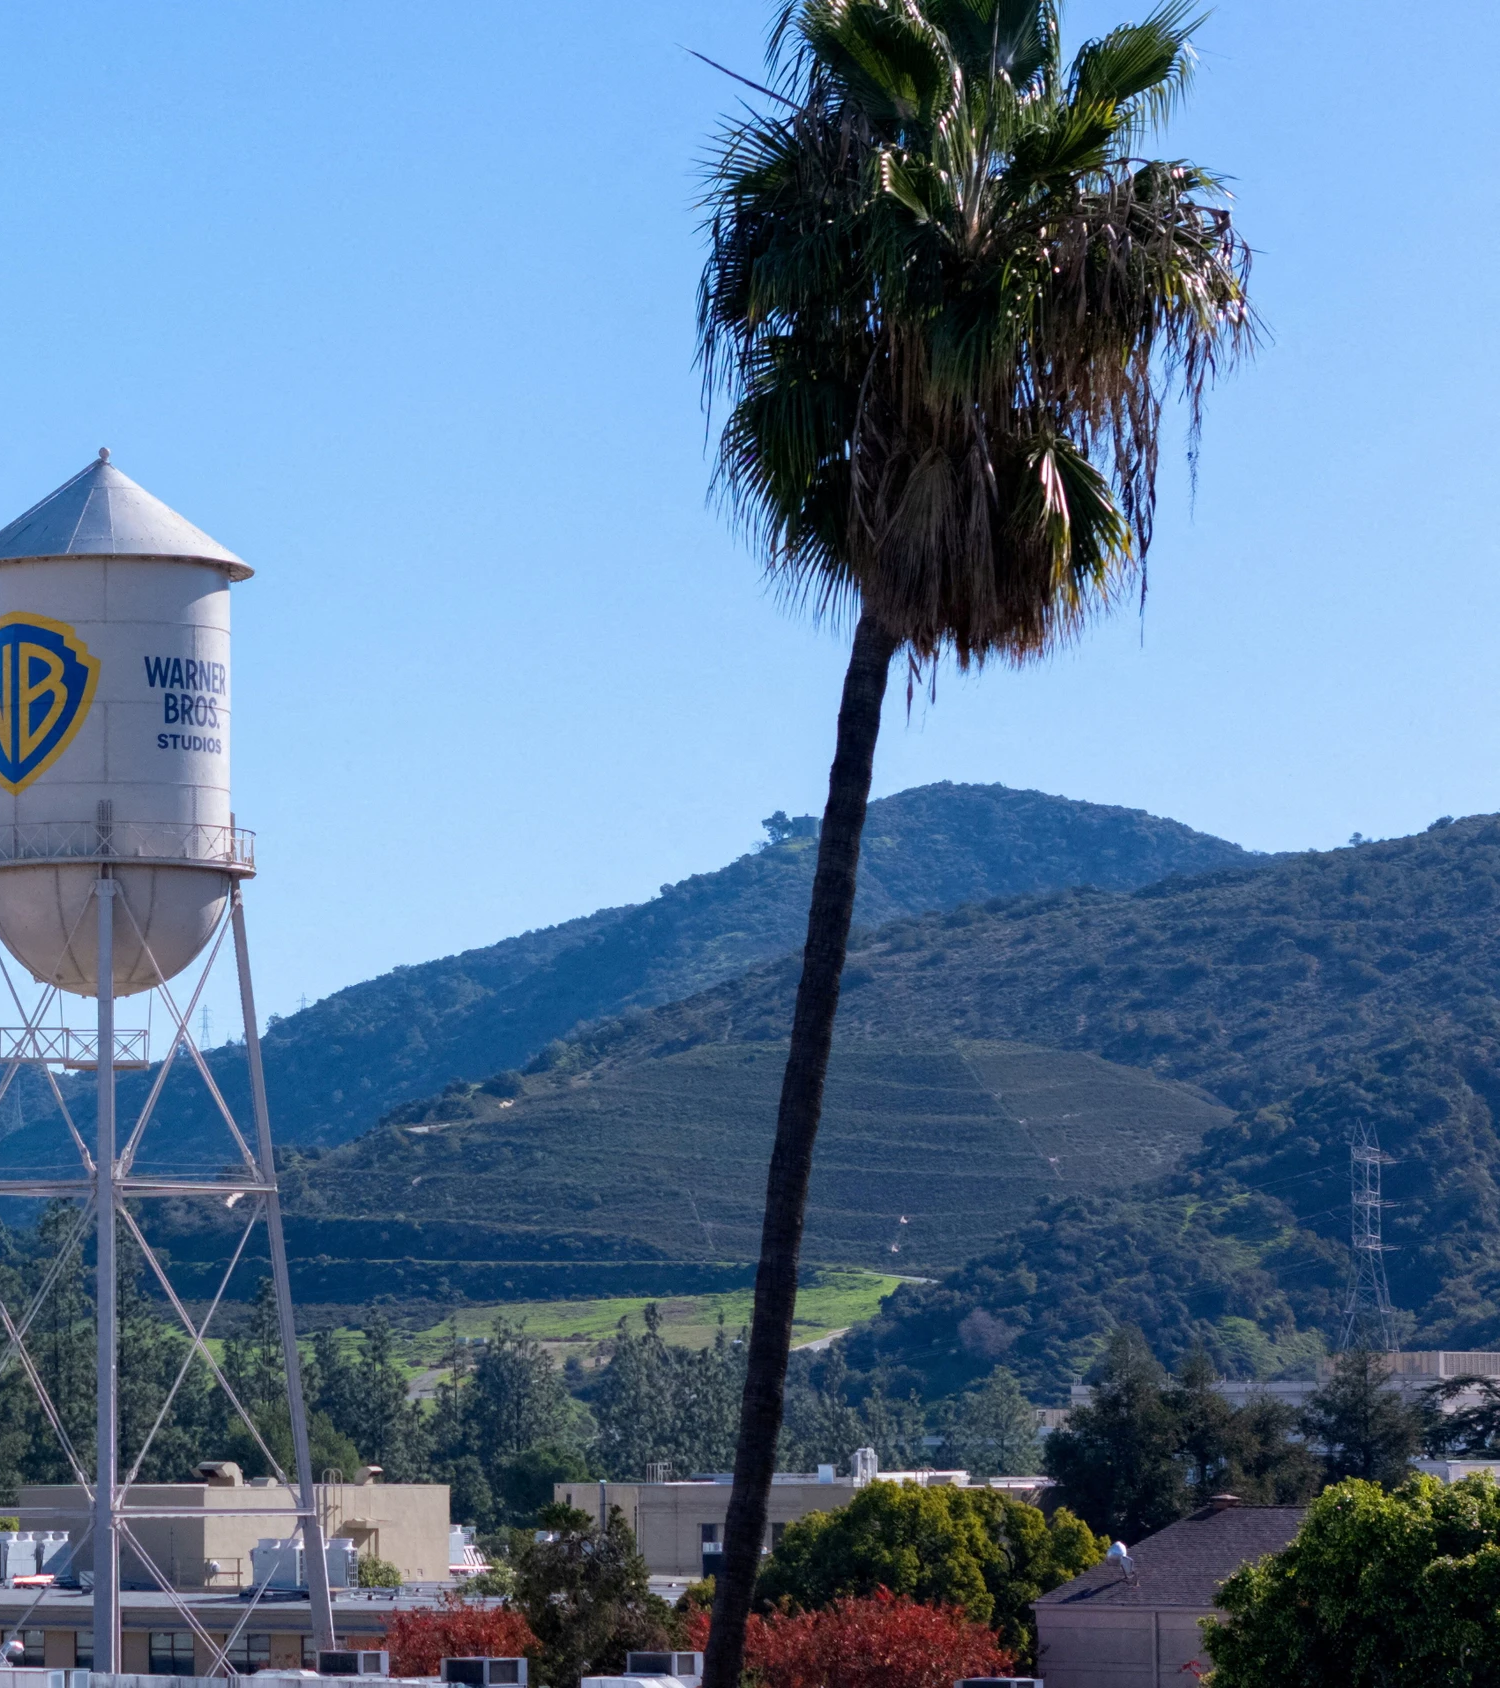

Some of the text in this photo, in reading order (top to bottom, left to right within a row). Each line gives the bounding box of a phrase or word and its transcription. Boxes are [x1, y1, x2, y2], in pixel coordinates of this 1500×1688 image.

[144, 656, 226, 696] WARNER
[164, 693, 220, 729] BROS.
[157, 733, 222, 754] STUDIOS
